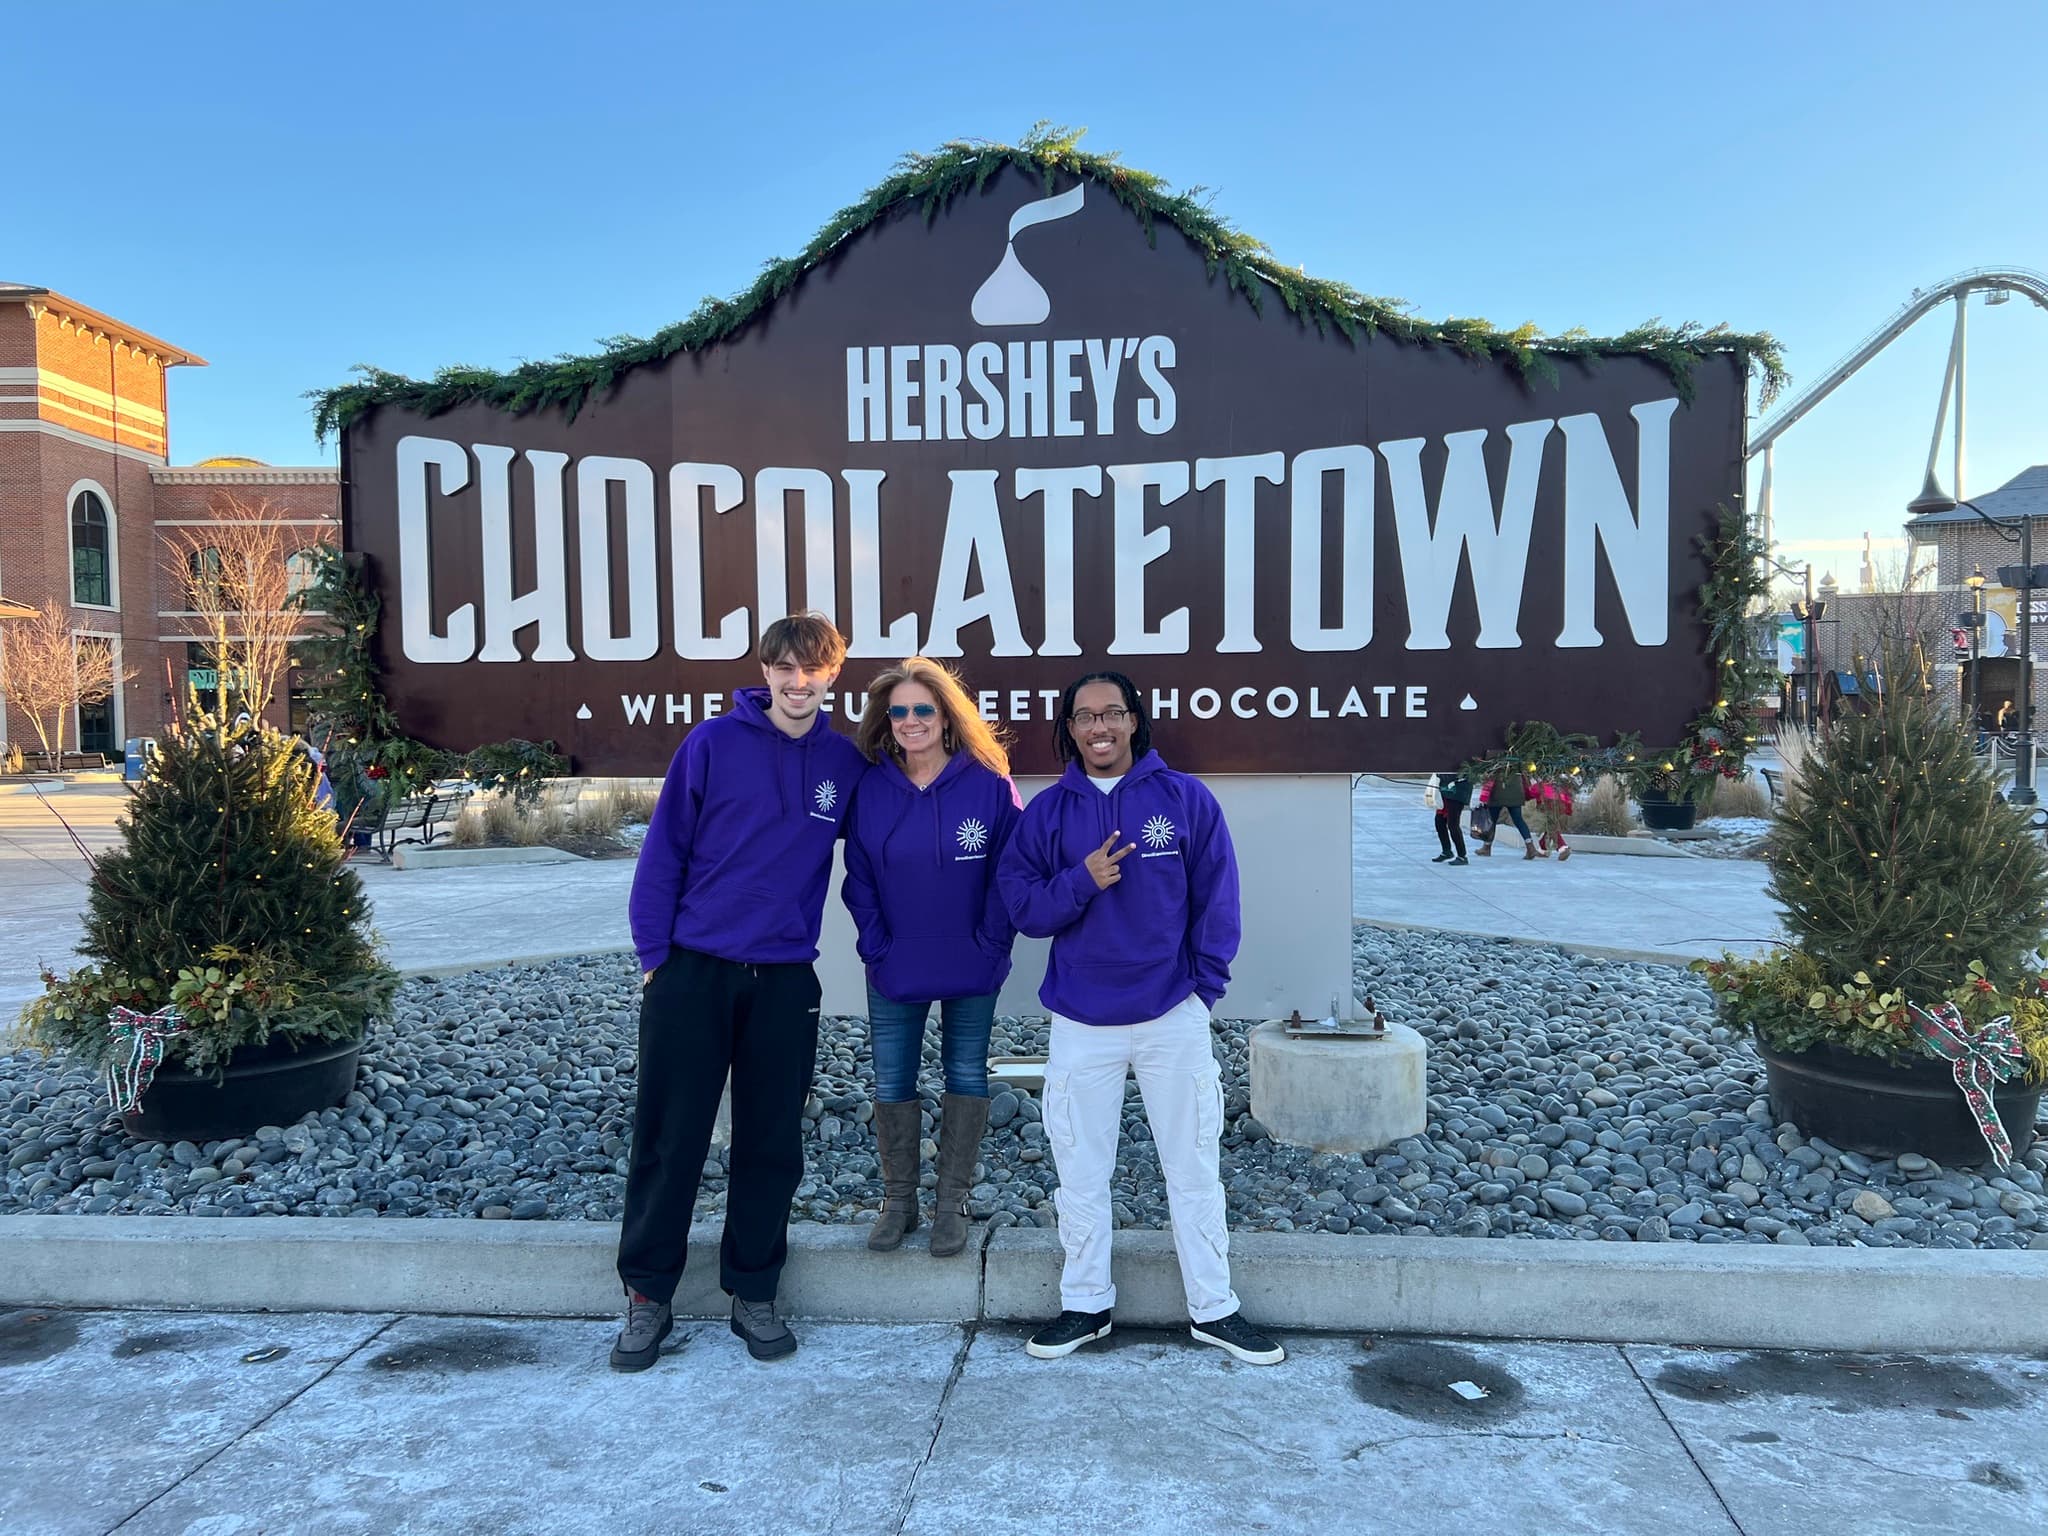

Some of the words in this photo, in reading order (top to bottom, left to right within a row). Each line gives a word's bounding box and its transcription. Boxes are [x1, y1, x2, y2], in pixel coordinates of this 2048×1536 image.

[846, 335, 1177, 442] HERSHEY'S
[395, 397, 1680, 664] CHOCOLATETOWN
[621, 693, 724, 725] WHE
[977, 690, 1061, 721] EET
[1136, 686, 1429, 719] HOCOLATE
